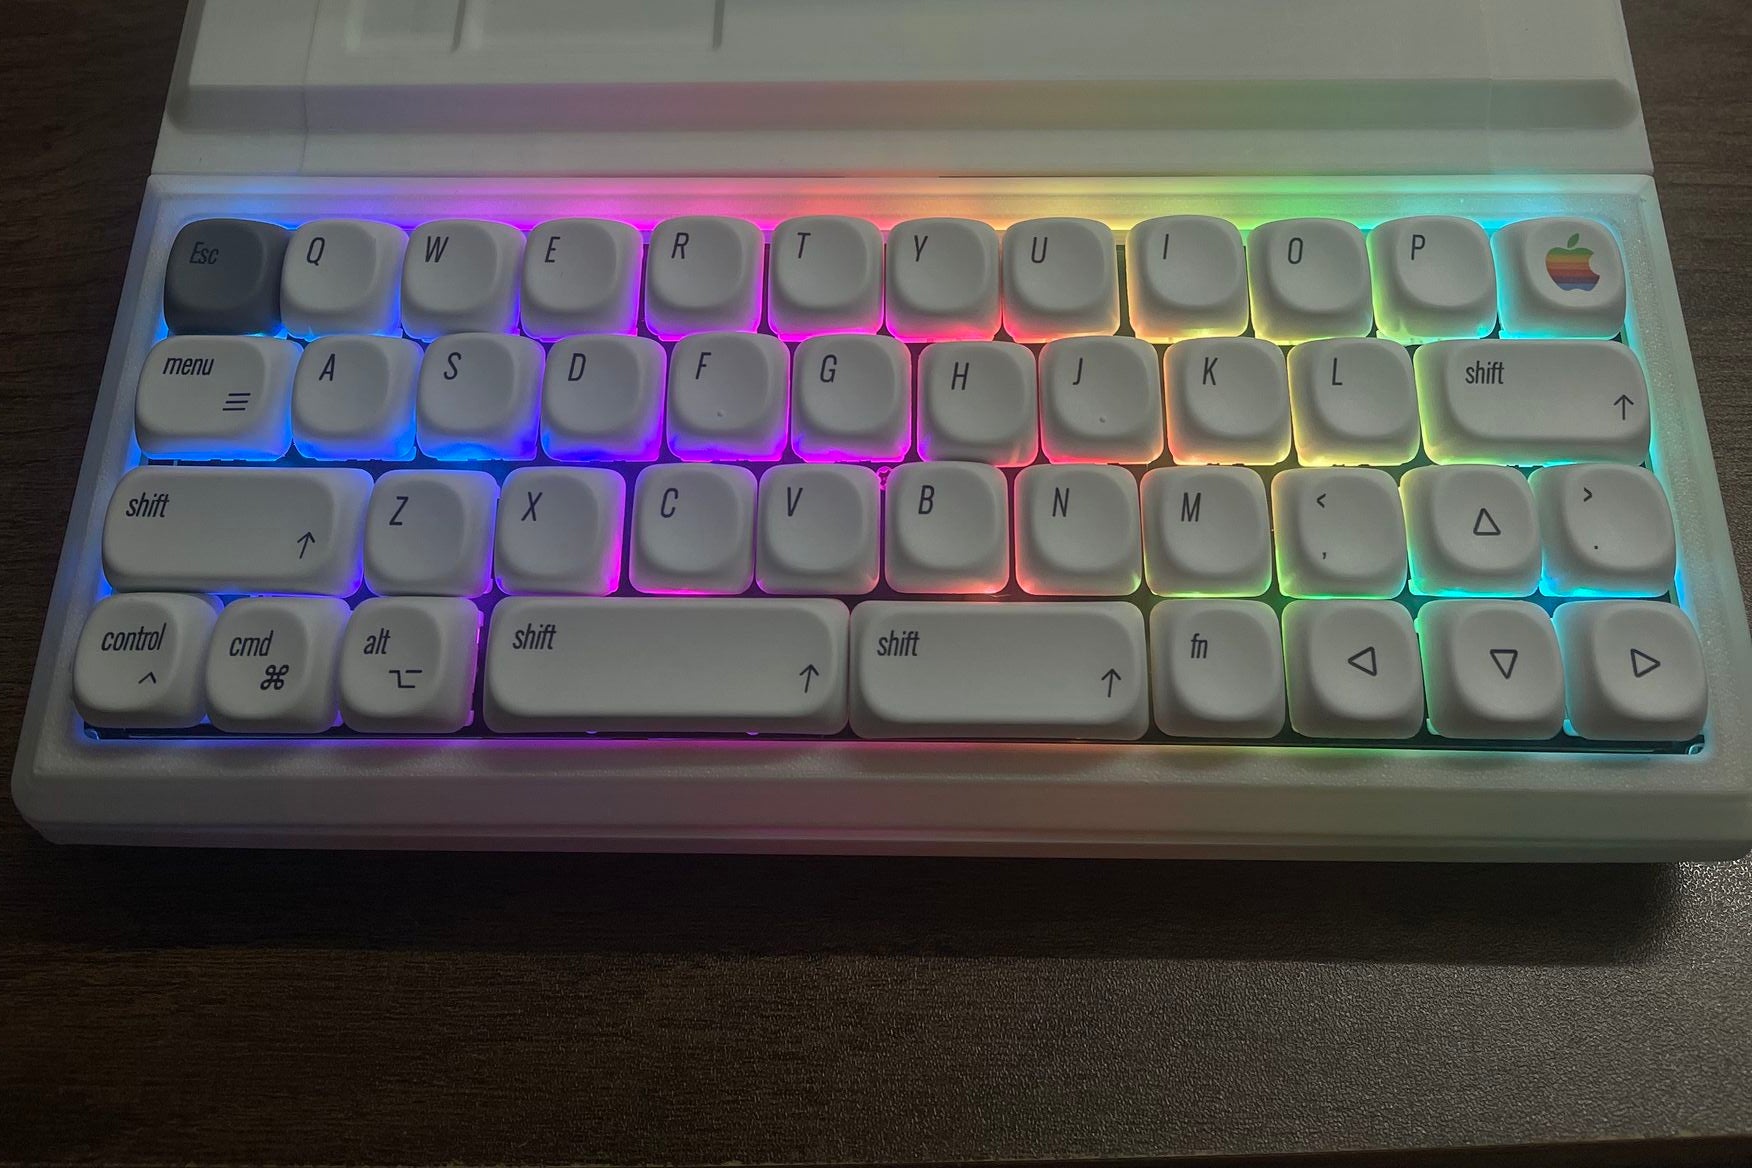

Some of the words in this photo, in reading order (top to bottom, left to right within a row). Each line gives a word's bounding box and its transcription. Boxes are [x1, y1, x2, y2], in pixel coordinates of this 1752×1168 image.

[189, 242, 218, 265] Esc
[307, 237, 325, 266] Q
[425, 236, 449, 263] W
[545, 237, 560, 263] E
[672, 233, 689, 259] R
[797, 232, 811, 258] T
[914, 235, 928, 262] Y
[1031, 237, 1048, 263] U
[1163, 234, 1169, 259] I
[1288, 237, 1303, 264] O
[1411, 234, 1425, 260] P
[163, 357, 214, 376] menu
[319, 354, 335, 381] A
[444, 352, 461, 380] S
[568, 353, 586, 381] D
[696, 352, 711, 379] F
[820, 355, 837, 383] G
[951, 362, 969, 390] H
[1073, 358, 1083, 385] J
[1203, 357, 1218, 385] K
[1332, 358, 1342, 386] L
[1465, 361, 1504, 384] shift
[126, 492, 169, 518] shift
[389, 496, 408, 526] Z
[521, 492, 542, 521] X
[661, 488, 679, 518] C
[786, 487, 803, 516] V
[918, 485, 934, 514] B
[1052, 487, 1069, 517] N
[1181, 492, 1201, 522] M
[101, 623, 166, 651] control
[229, 630, 273, 656] cmd
[364, 628, 390, 655] alt
[513, 623, 556, 650] shift
[877, 630, 920, 657] shift
[1191, 633, 1207, 659] fn
